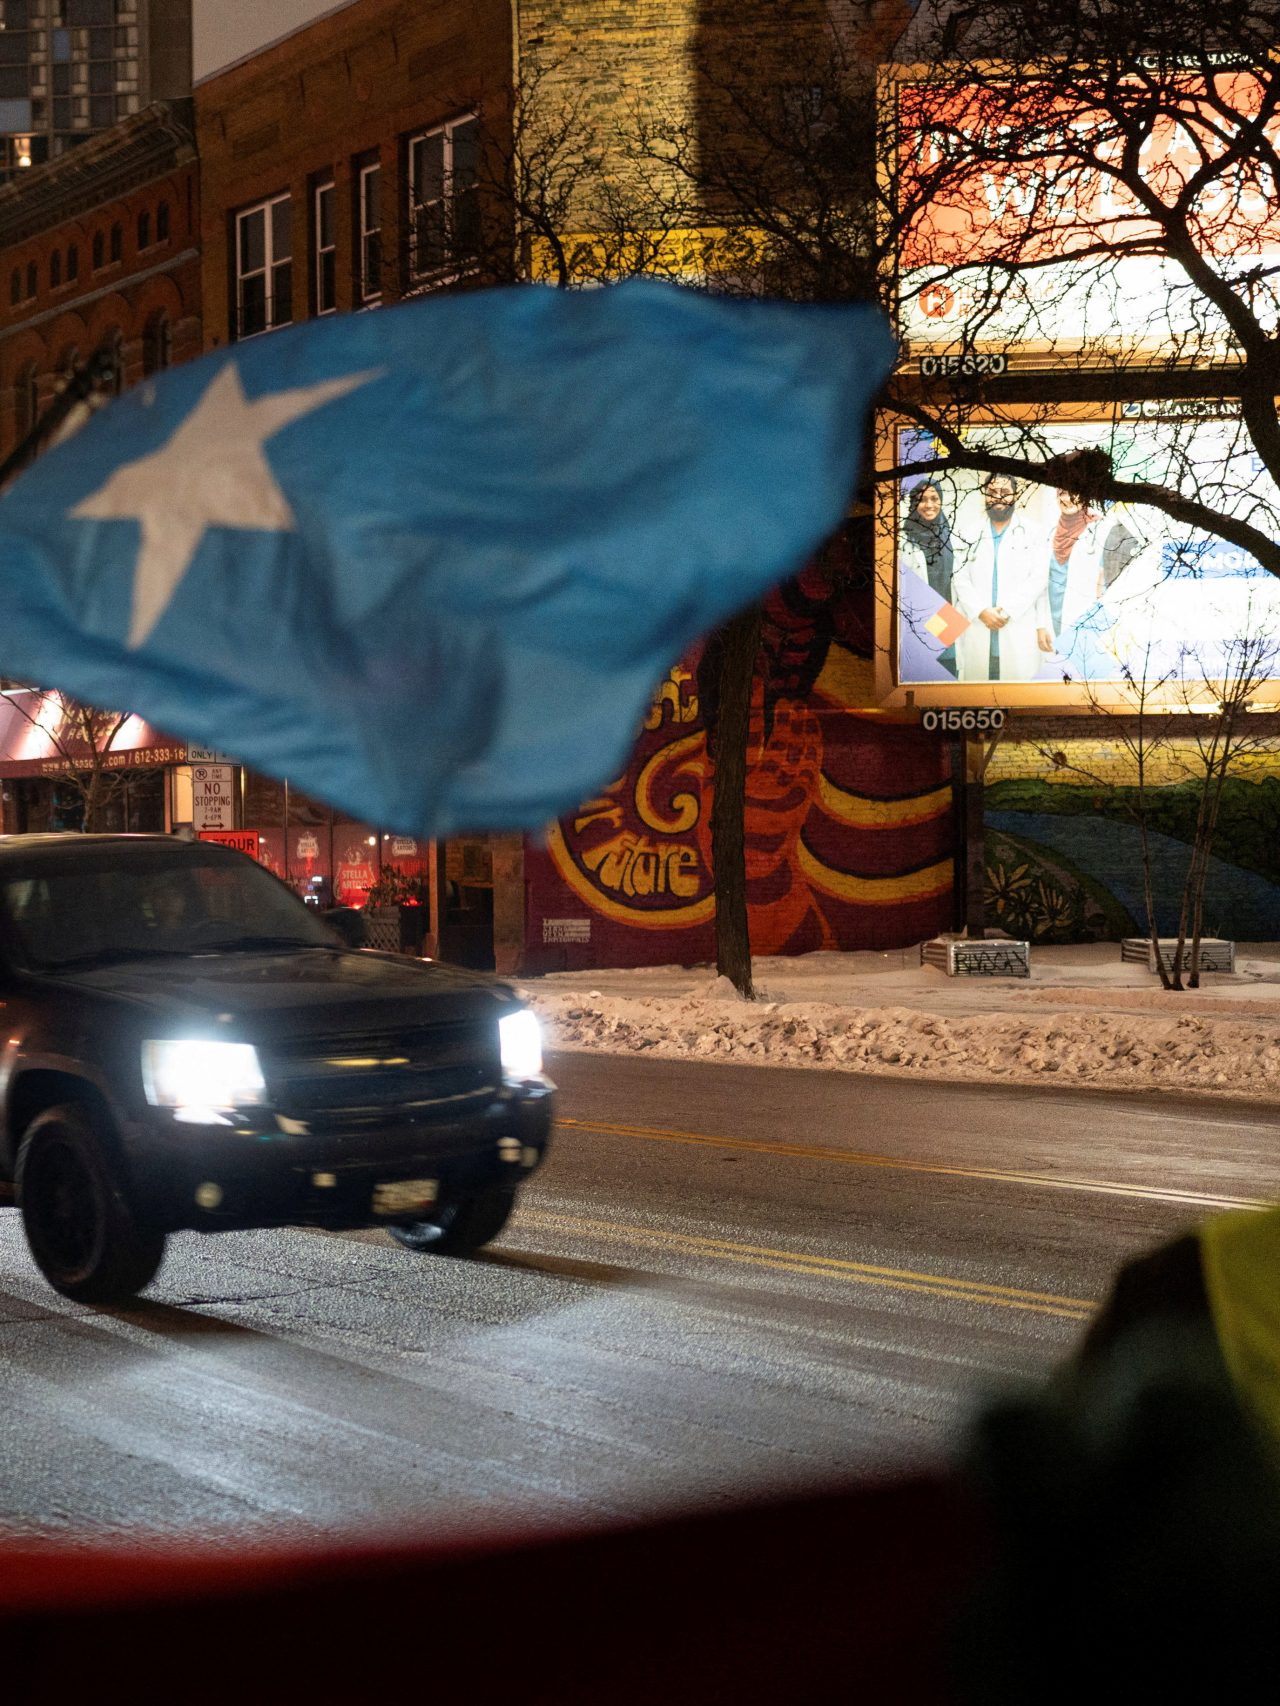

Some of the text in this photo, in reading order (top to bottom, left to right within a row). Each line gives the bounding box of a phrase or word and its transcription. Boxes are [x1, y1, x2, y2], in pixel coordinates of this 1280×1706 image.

[923, 710, 1004, 730] 015650
[134, 748, 186, 764] 612-333-16
[192, 750, 212, 759] ONLY
[204, 783, 221, 794] NO
[195, 797, 230, 806] STOPPING
[342, 870, 368, 879] STELLA
